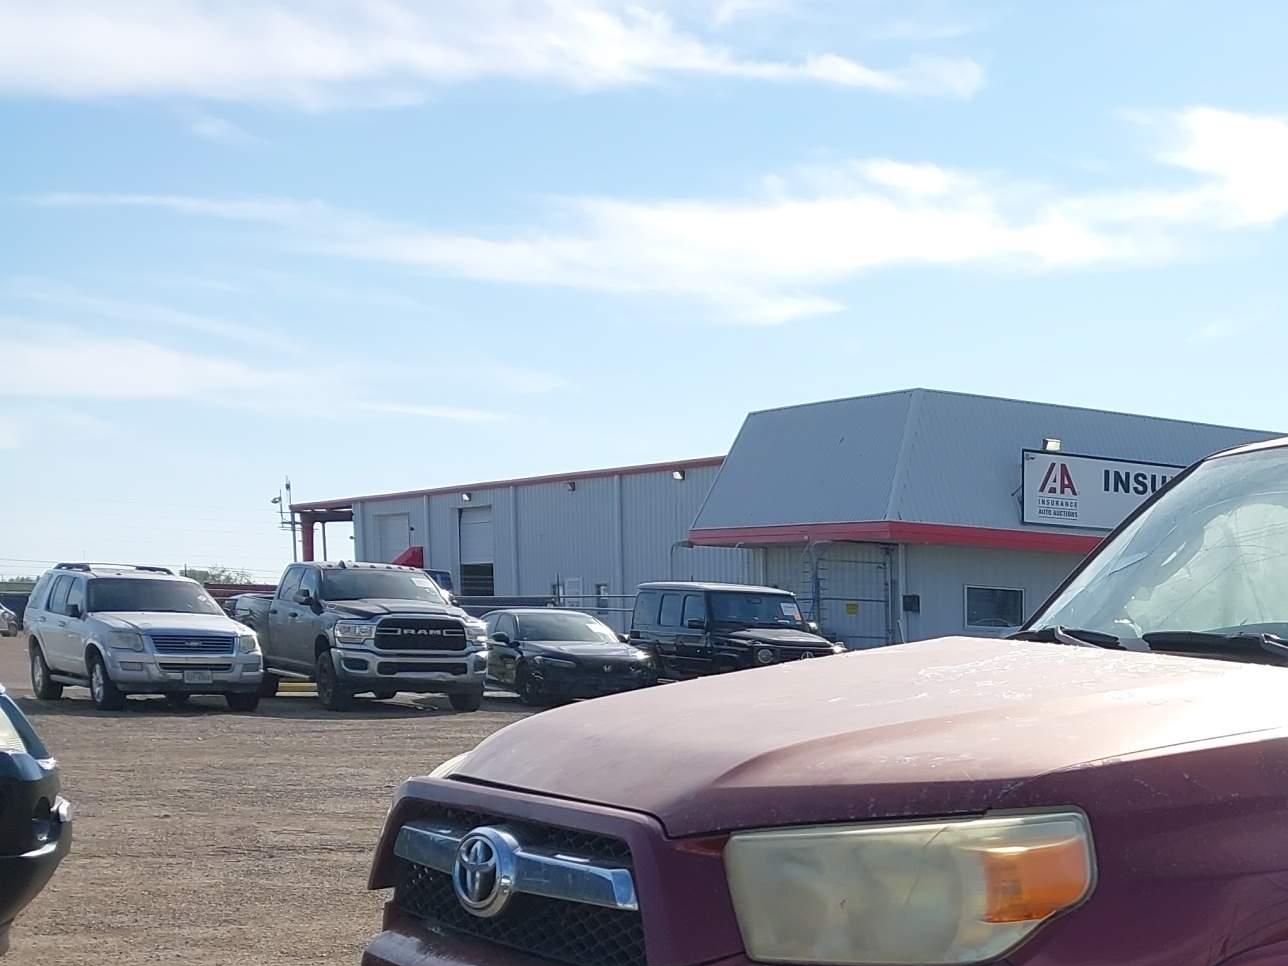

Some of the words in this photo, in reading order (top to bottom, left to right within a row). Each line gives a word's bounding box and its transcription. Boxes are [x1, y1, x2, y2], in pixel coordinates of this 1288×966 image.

[1103, 469, 1174, 496] INSU
[1038, 498, 1078, 508] INSURANCE
[1038, 508, 1052, 516] AUTO
[1053, 510, 1078, 518] AUCTIONS
